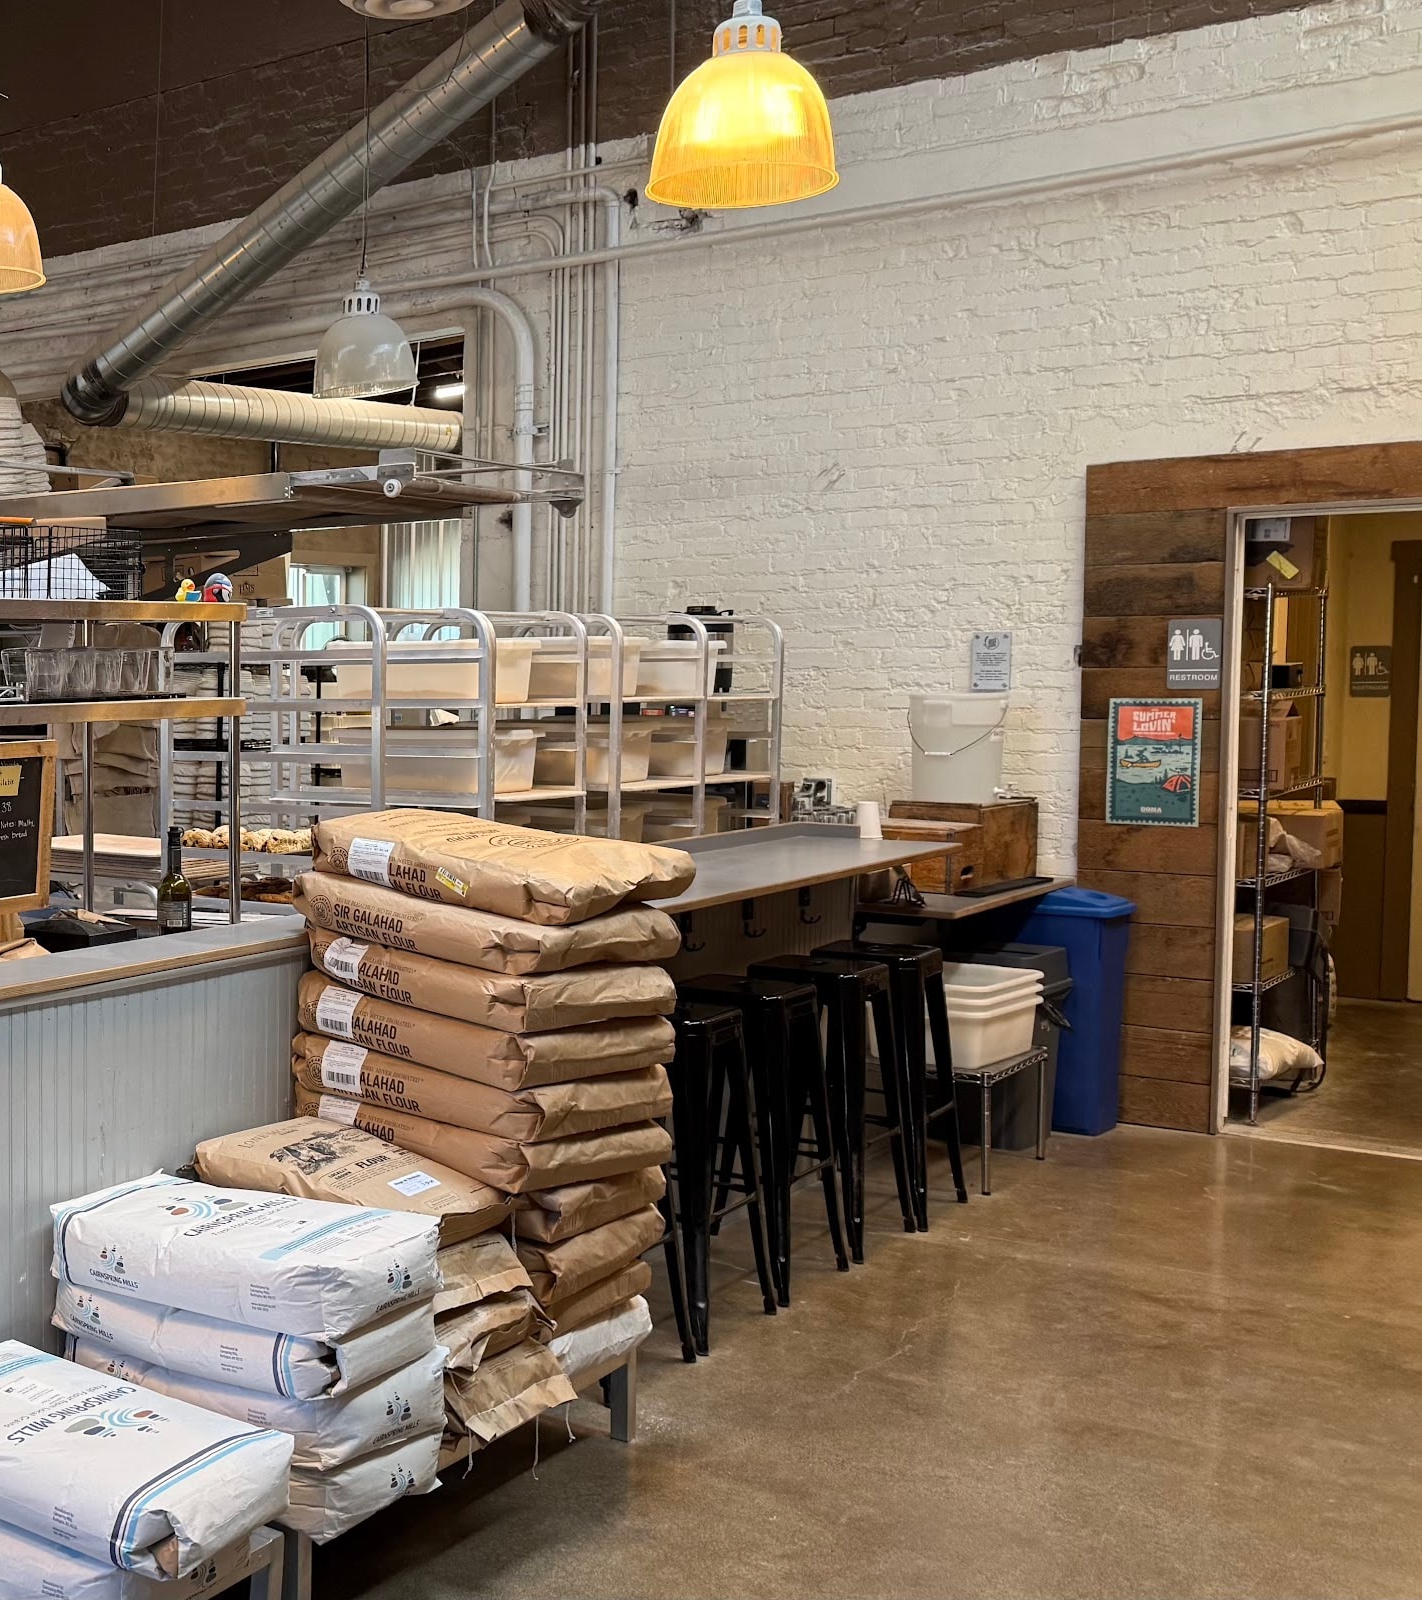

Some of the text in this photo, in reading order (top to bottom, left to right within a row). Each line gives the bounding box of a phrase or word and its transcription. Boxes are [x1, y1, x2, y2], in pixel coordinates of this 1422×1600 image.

[1169, 673, 1219, 682] RESTROOM
[1132, 710, 1177, 722] SUMMER
[1132, 718, 1177, 732] LOVIN'
[1, 801, 12, 813] 38
[388, 862, 426, 883] LAHAD
[406, 882, 443, 900] FLOUR
[333, 903, 404, 934] SIR GALAHAD
[336, 919, 418, 951] ARTISAN FLOUR
[358, 961, 400, 986] ALAHAD
[379, 985, 413, 1004] FLOUR
[352, 1016, 397, 1040] ALAHAD
[376, 1039, 413, 1058] FLOUR
[360, 1071, 405, 1095] ALAHAD
[383, 1094, 422, 1113] FLOUR
[355, 1154, 391, 1169] FLOUR
[89, 1268, 123, 1284] CAIRNSPRING
[122, 1279, 139, 1289] MILLS
[375, 1288, 421, 1313] CAIRNSPRING MILLS
[98, 1329, 114, 1340] MILLS
[7, 1386, 137, 1444] CAIRNSPRING MILLS
[373, 1419, 420, 1445] CAIRNSPRING MILLS
